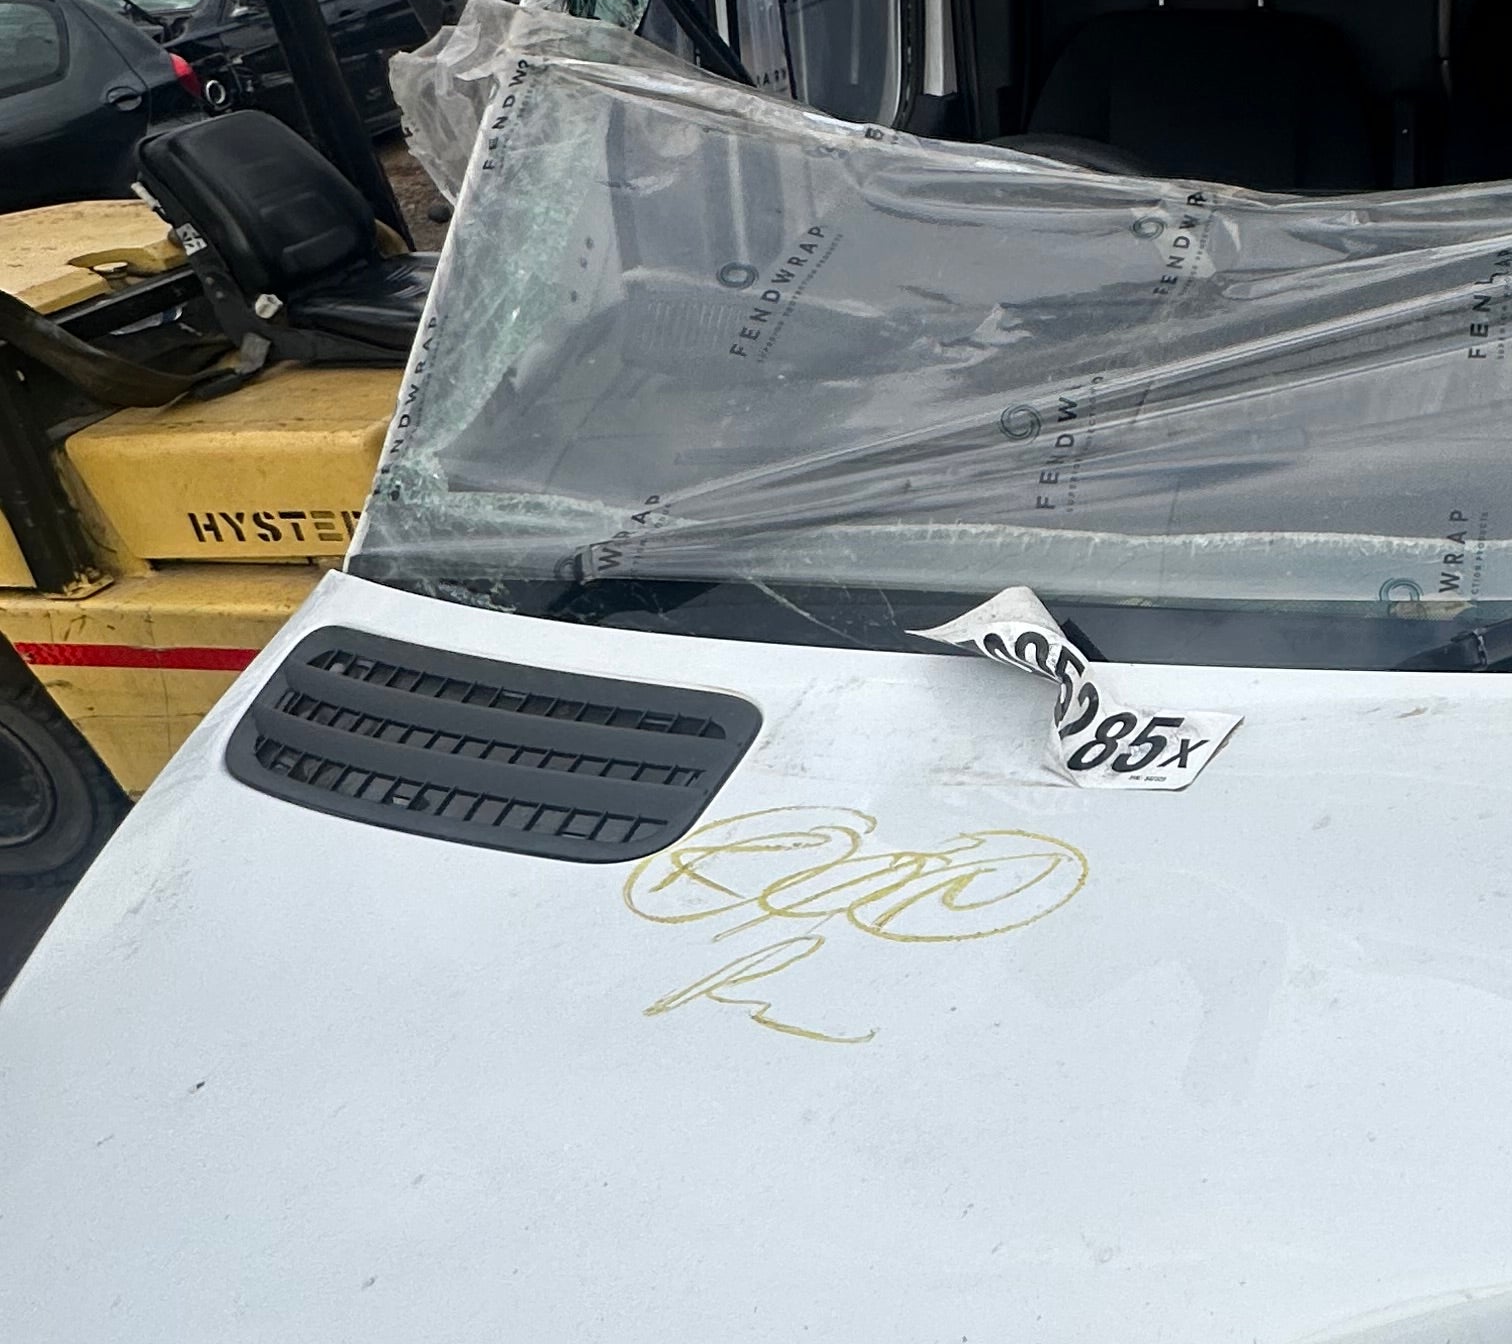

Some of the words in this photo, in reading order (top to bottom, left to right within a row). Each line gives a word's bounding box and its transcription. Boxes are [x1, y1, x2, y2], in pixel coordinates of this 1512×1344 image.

[729, 225, 825, 357] FENDWRAP
[373, 316, 438, 496] FENDWRAP
[1438, 509, 1469, 594] WRAP
